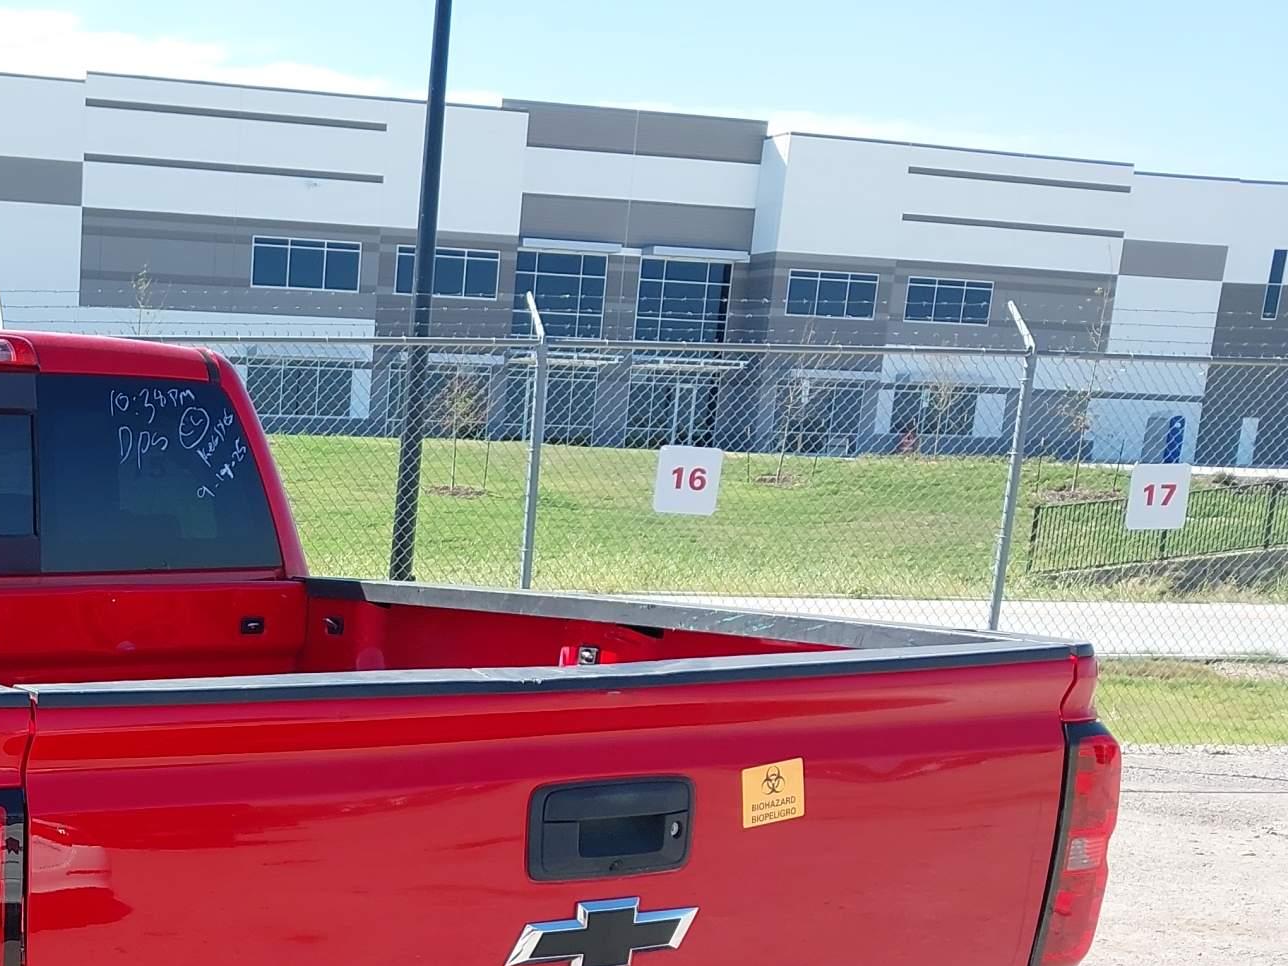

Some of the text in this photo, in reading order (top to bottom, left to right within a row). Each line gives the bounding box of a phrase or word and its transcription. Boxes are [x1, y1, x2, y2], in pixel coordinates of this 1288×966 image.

[671, 466, 708, 491] 16
[1143, 483, 1177, 506] 17
[751, 795, 797, 812] BIOHAZARD
[751, 807, 797, 824] BIOPELIGRO
